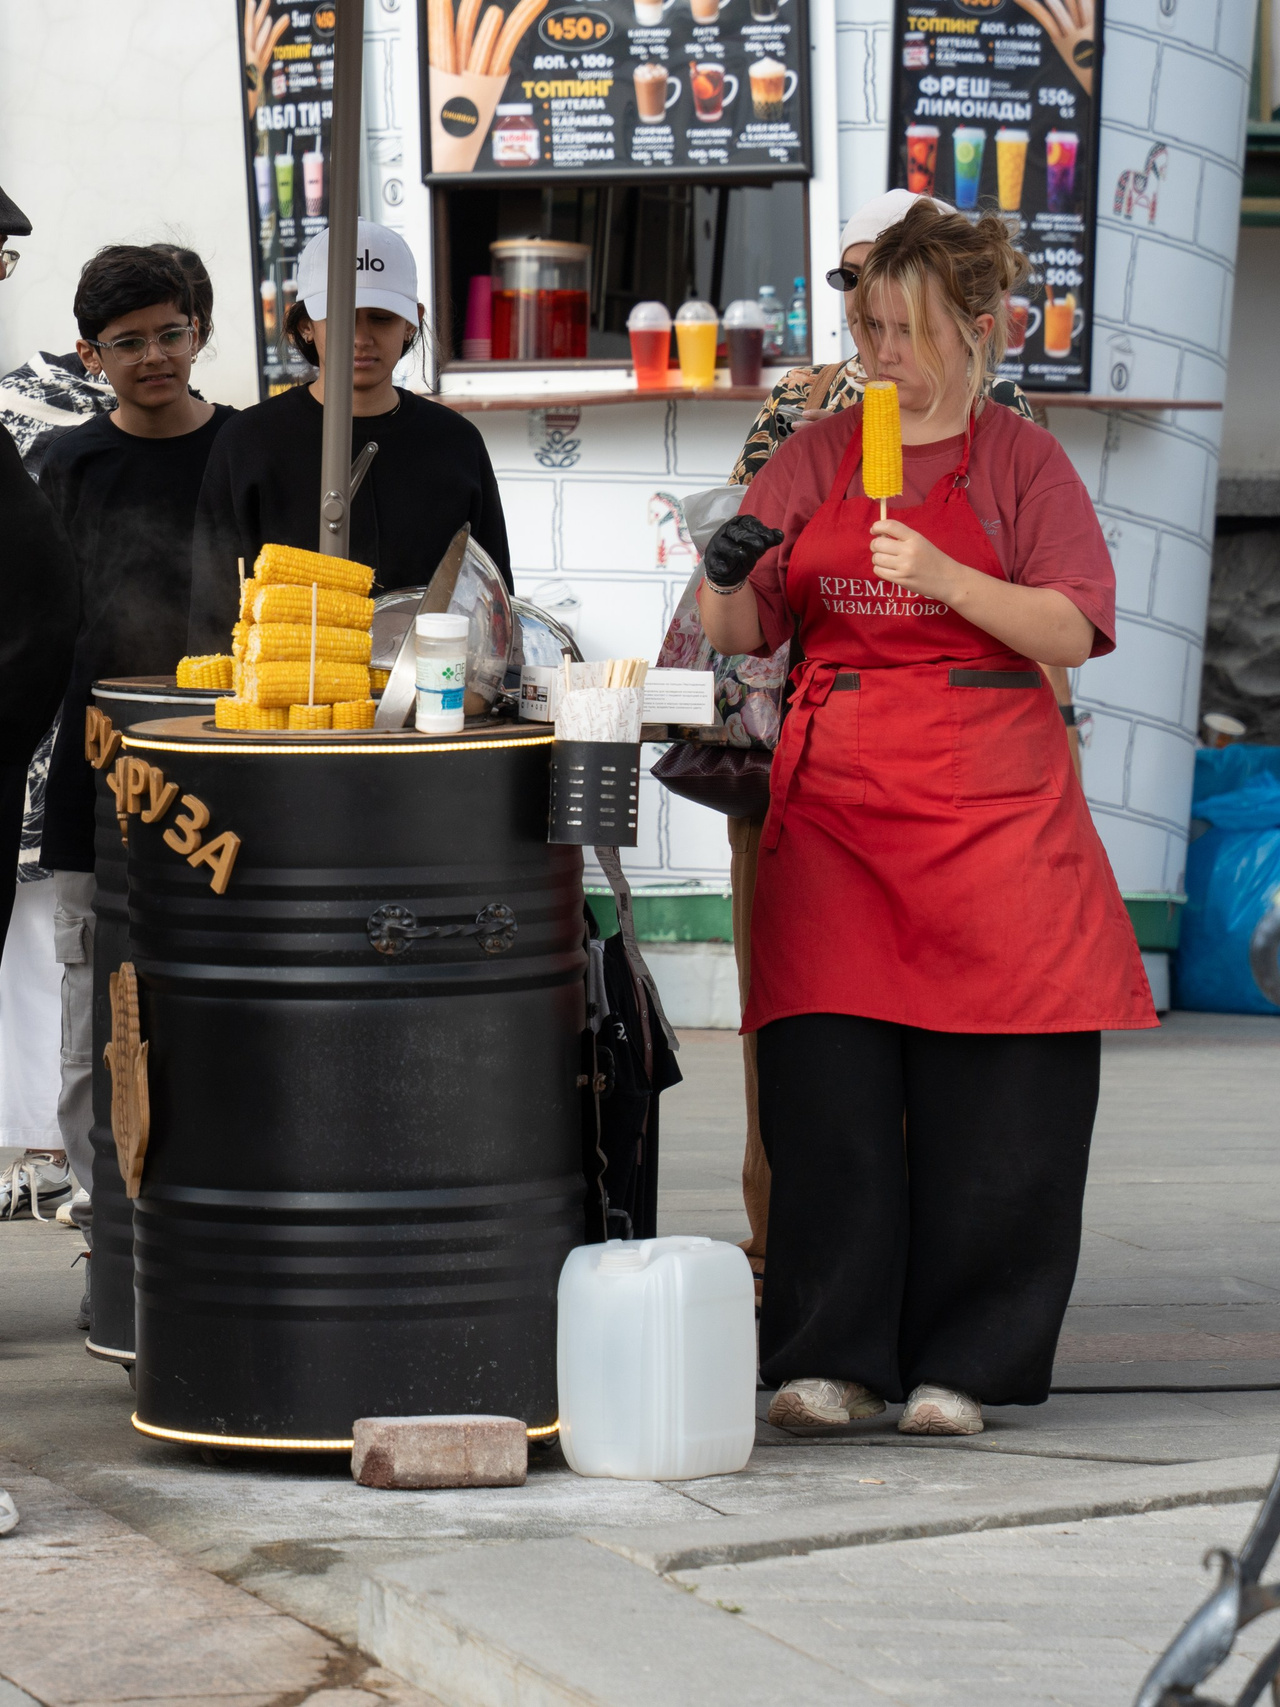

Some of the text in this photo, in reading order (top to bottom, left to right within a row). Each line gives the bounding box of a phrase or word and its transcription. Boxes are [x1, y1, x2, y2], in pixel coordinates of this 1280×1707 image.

[907, 17, 979, 34] ТОППИНГ
[521, 79, 614, 99] ТОППИНГ
[918, 75, 991, 98] ФРЕШ
[256, 103, 296, 131] БАБЛ
[297, 100, 321, 128] ТИ
[914, 97, 1032, 121] ЛИМОНАДЫ
[356, 249, 385, 272] alo
[832, 599, 948, 616] ИЗМАЙЛОВО
